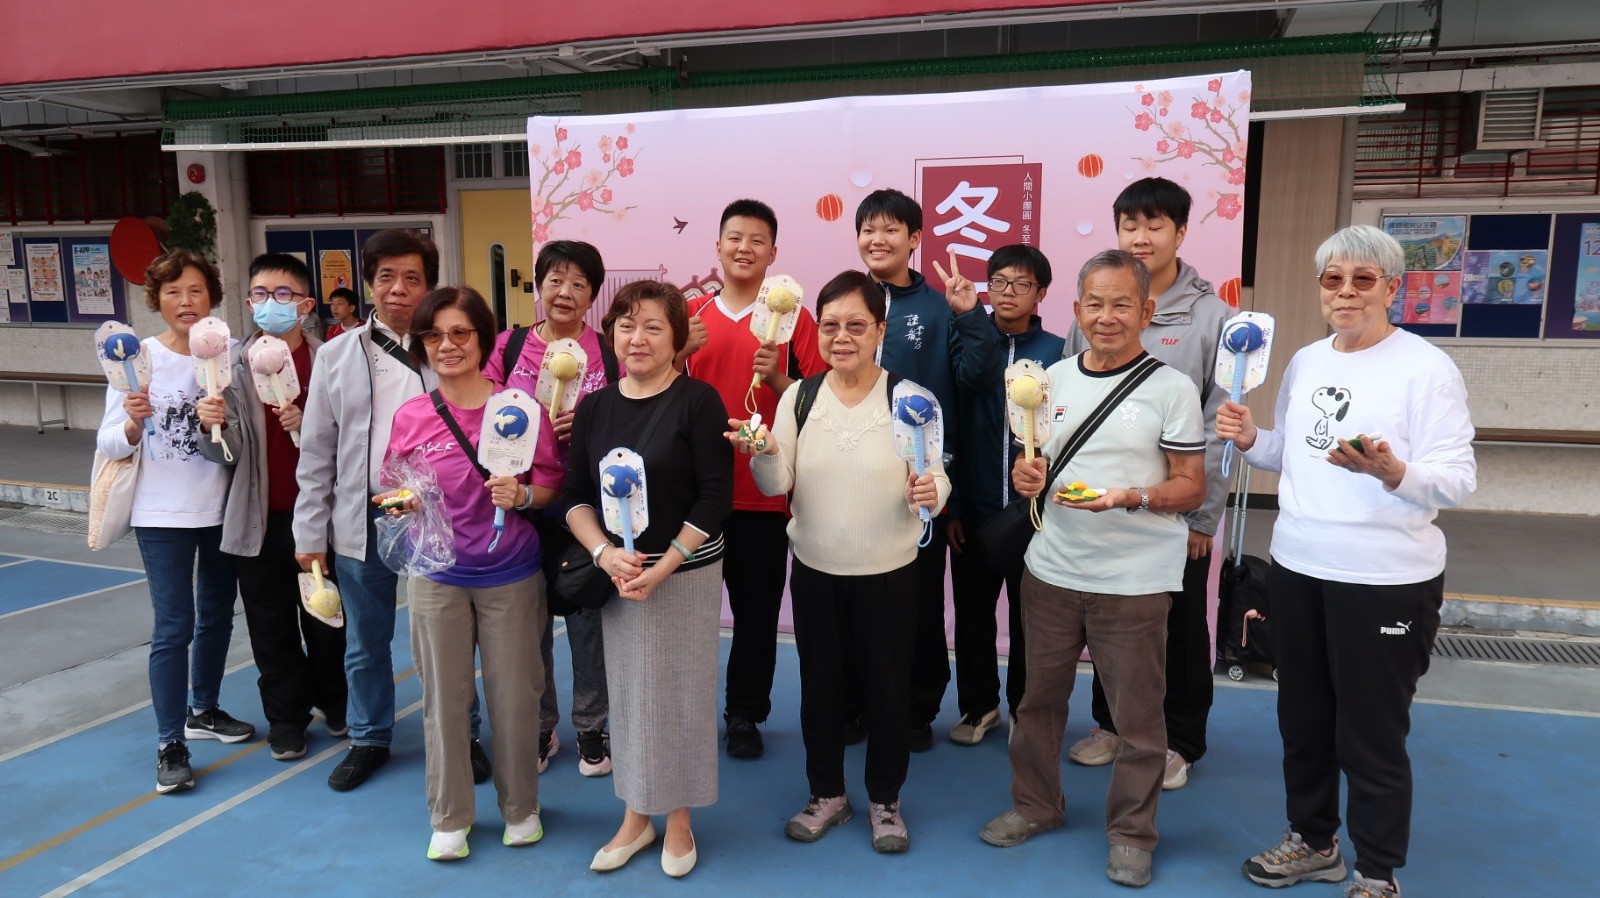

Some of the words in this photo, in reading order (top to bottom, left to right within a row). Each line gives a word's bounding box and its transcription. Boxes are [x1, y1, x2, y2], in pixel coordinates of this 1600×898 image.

[1022, 172, 1033, 220] 人間小團圓
[1021, 224, 1031, 245] 冬至
[47, 491, 58, 500] 2C
[1380, 626, 1405, 634] PUMA
